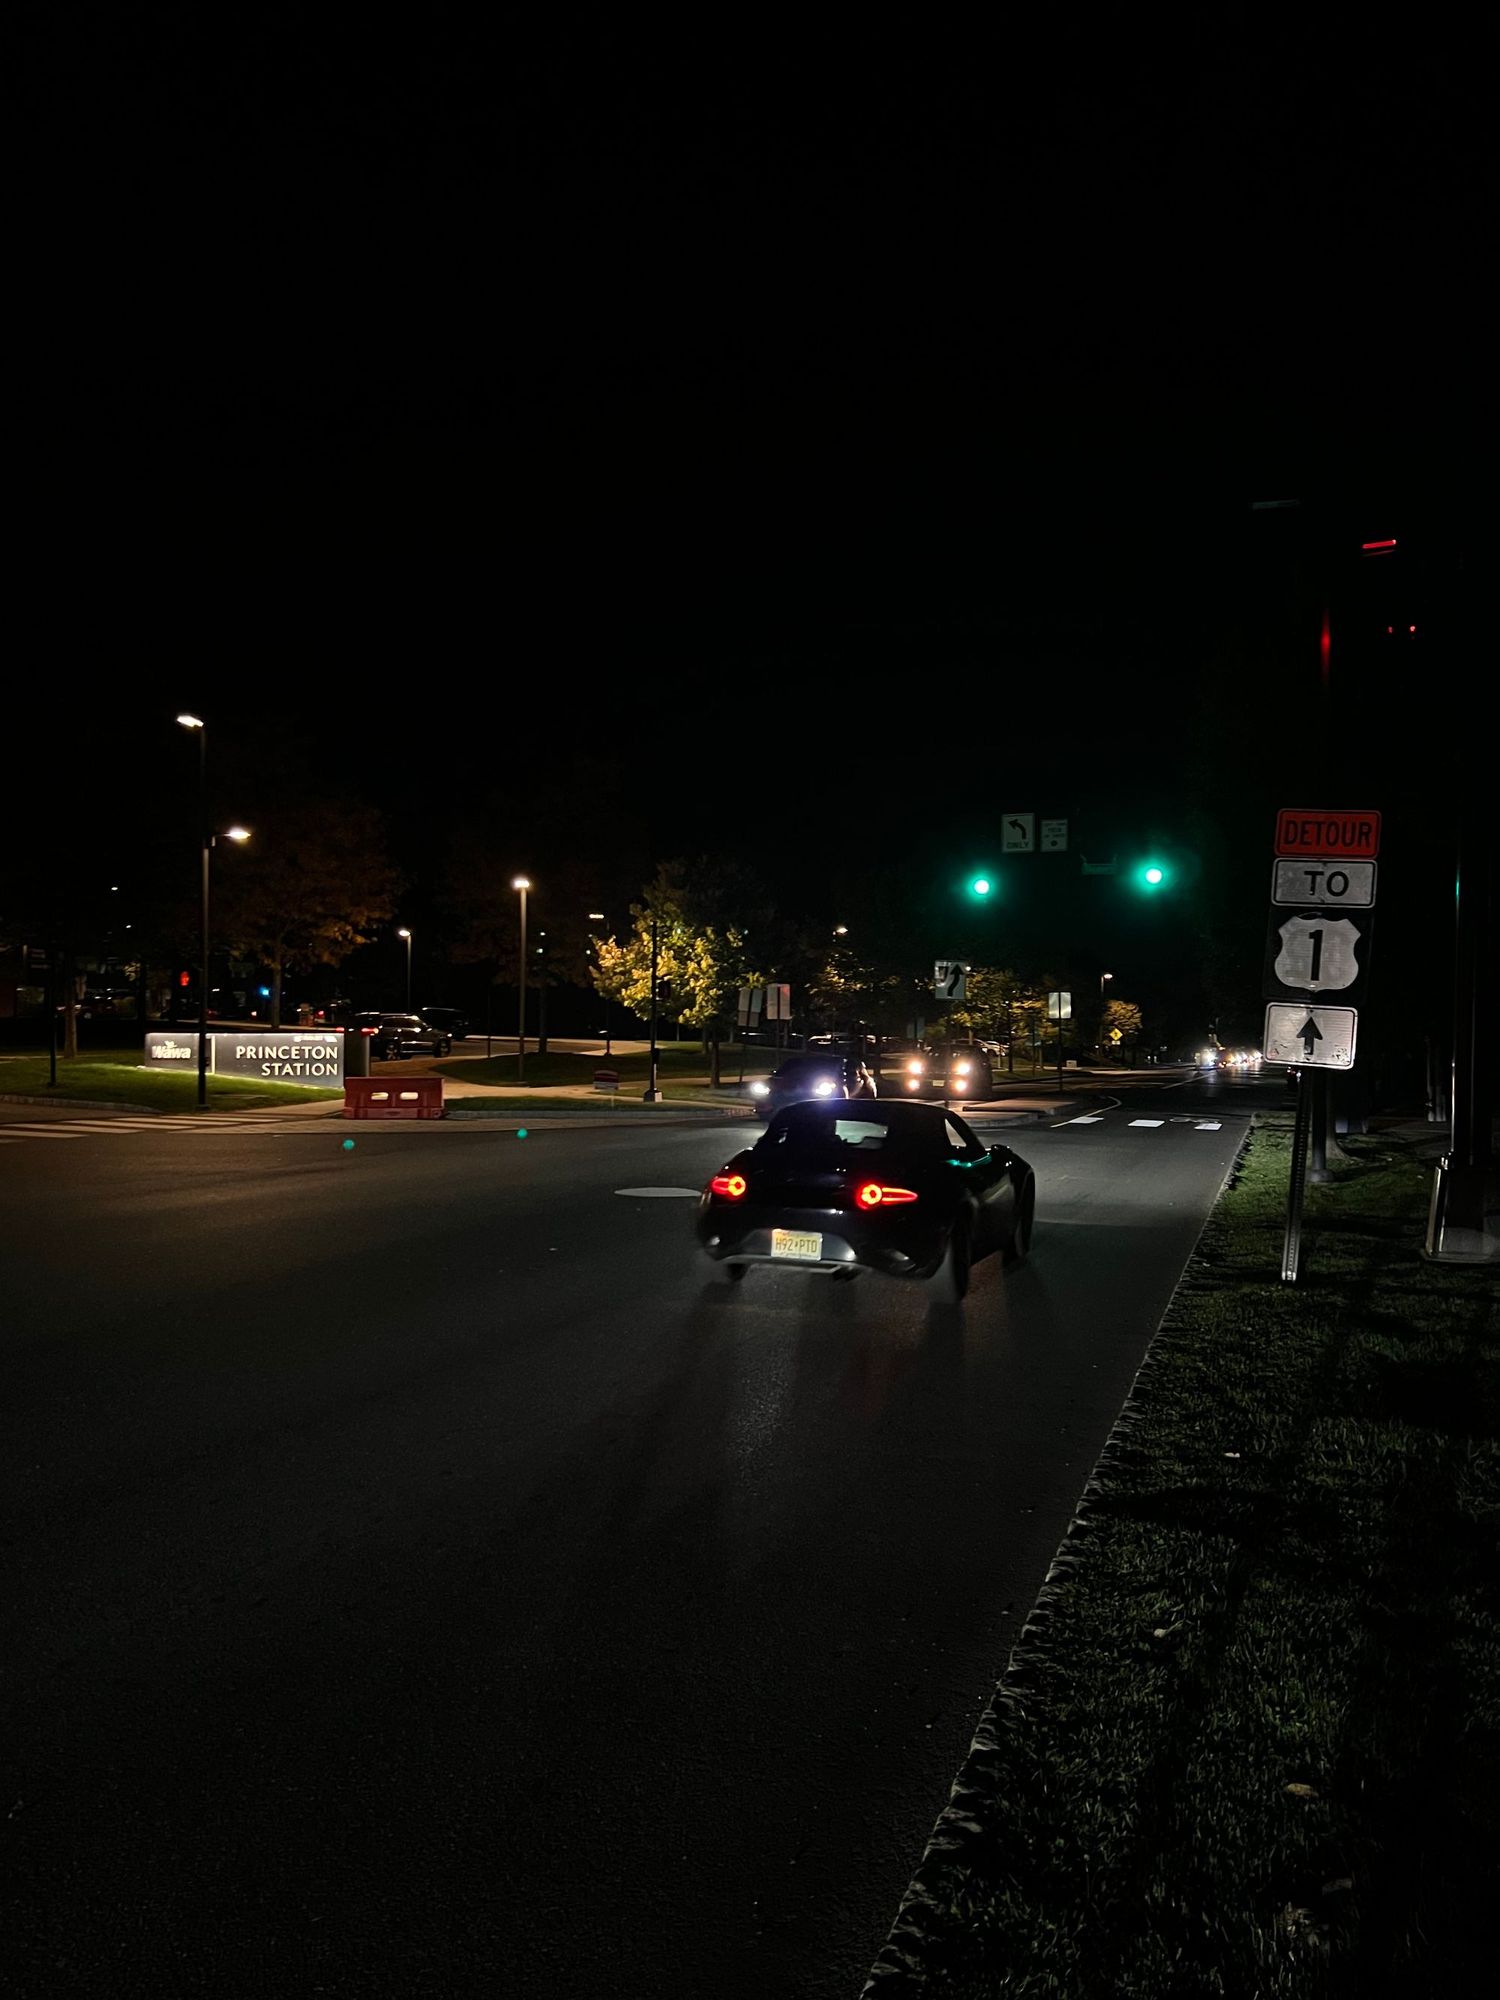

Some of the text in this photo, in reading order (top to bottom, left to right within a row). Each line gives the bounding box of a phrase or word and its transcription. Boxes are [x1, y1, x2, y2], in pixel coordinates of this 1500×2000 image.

[1284, 820, 1372, 848] DETOUR
[1304, 870, 1349, 896] TO
[1309, 929, 1323, 981] 1
[236, 1045, 338, 1060] PRINCETON
[261, 1062, 338, 1076] STATION
